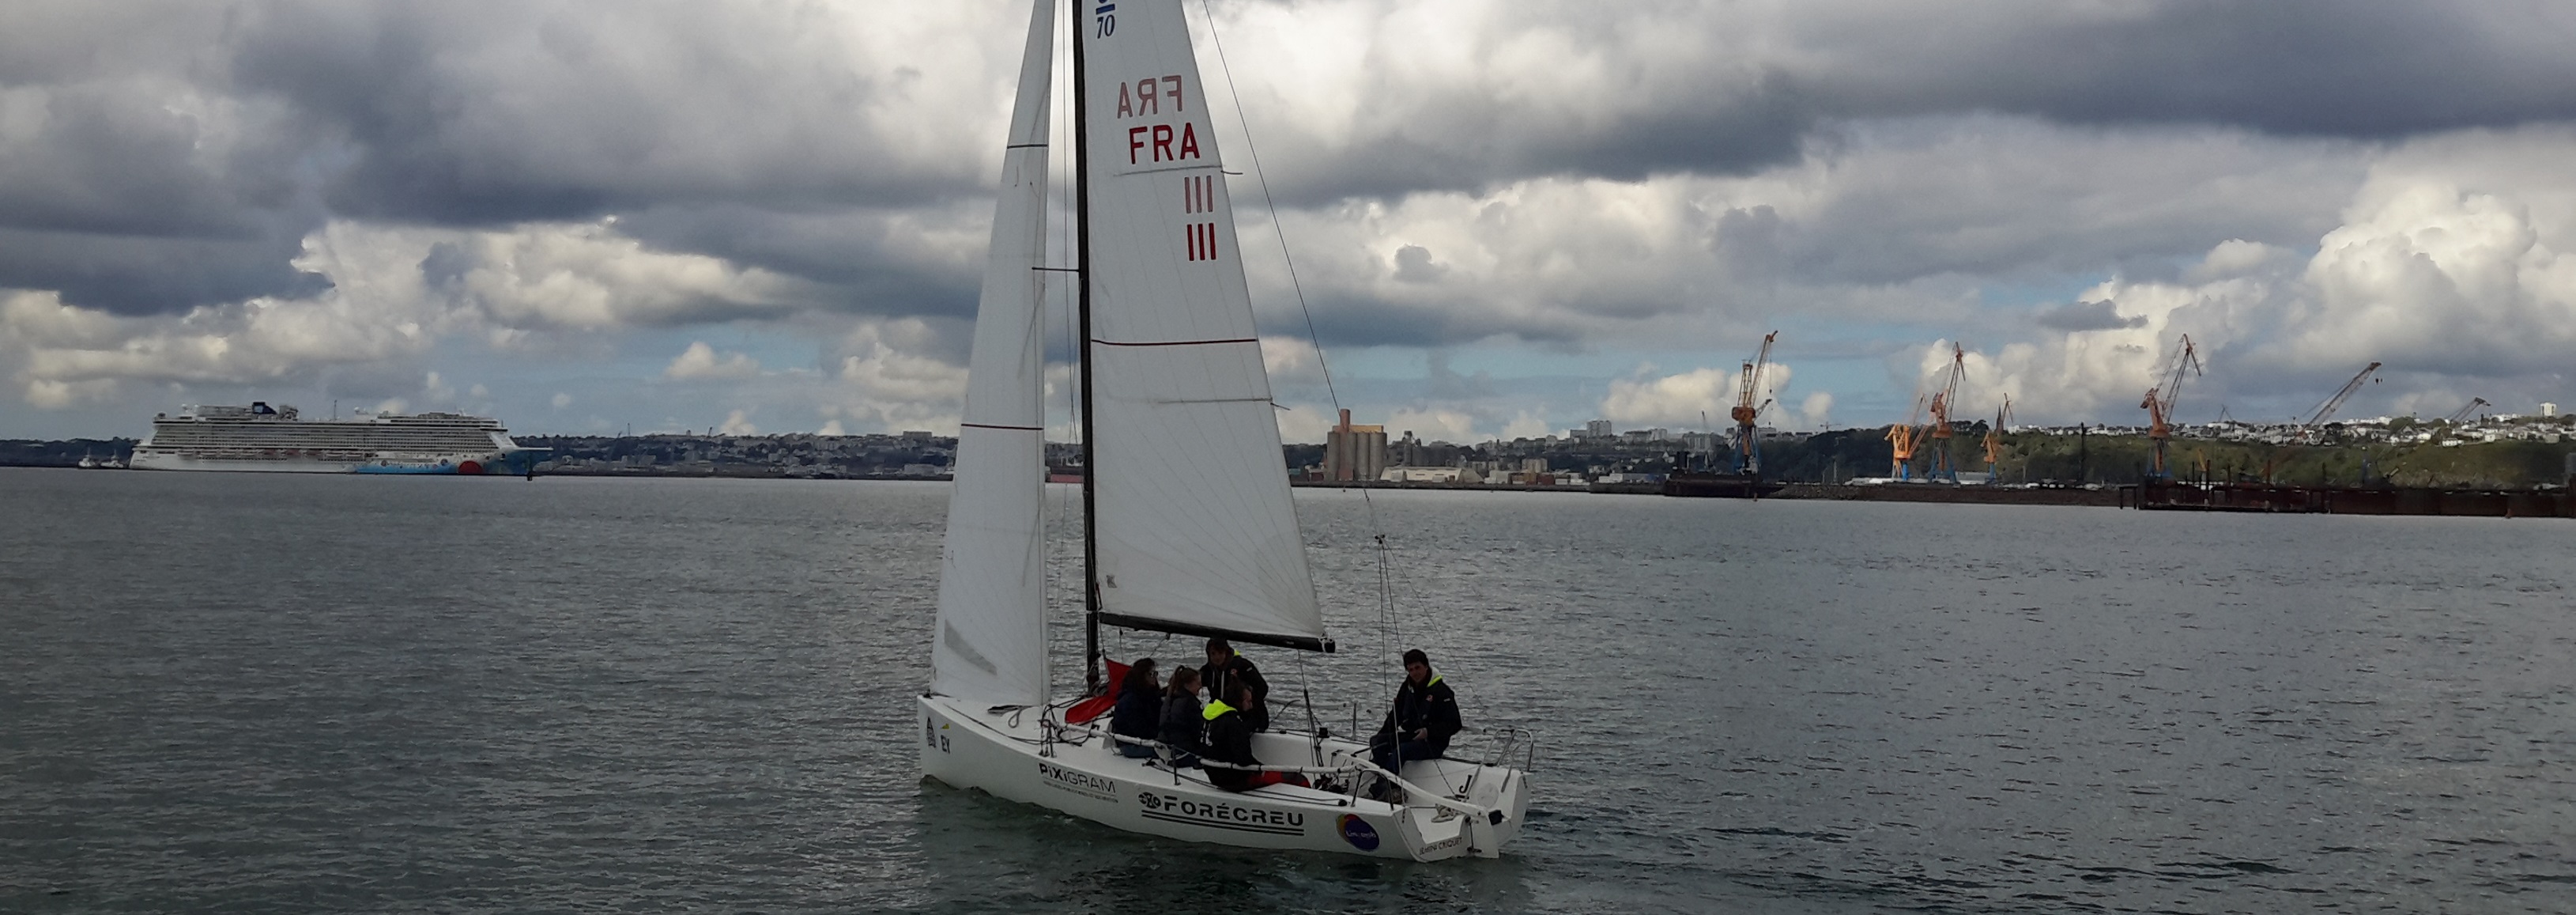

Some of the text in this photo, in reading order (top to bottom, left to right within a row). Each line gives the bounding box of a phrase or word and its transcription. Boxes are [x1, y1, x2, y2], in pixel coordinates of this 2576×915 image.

[1097, 14, 1115, 39] 70
[1129, 123, 1200, 164] FRA
[941, 735, 950, 754] EY
[1459, 774, 1472, 793] J
[1164, 795, 1304, 826] FORÉCREU
